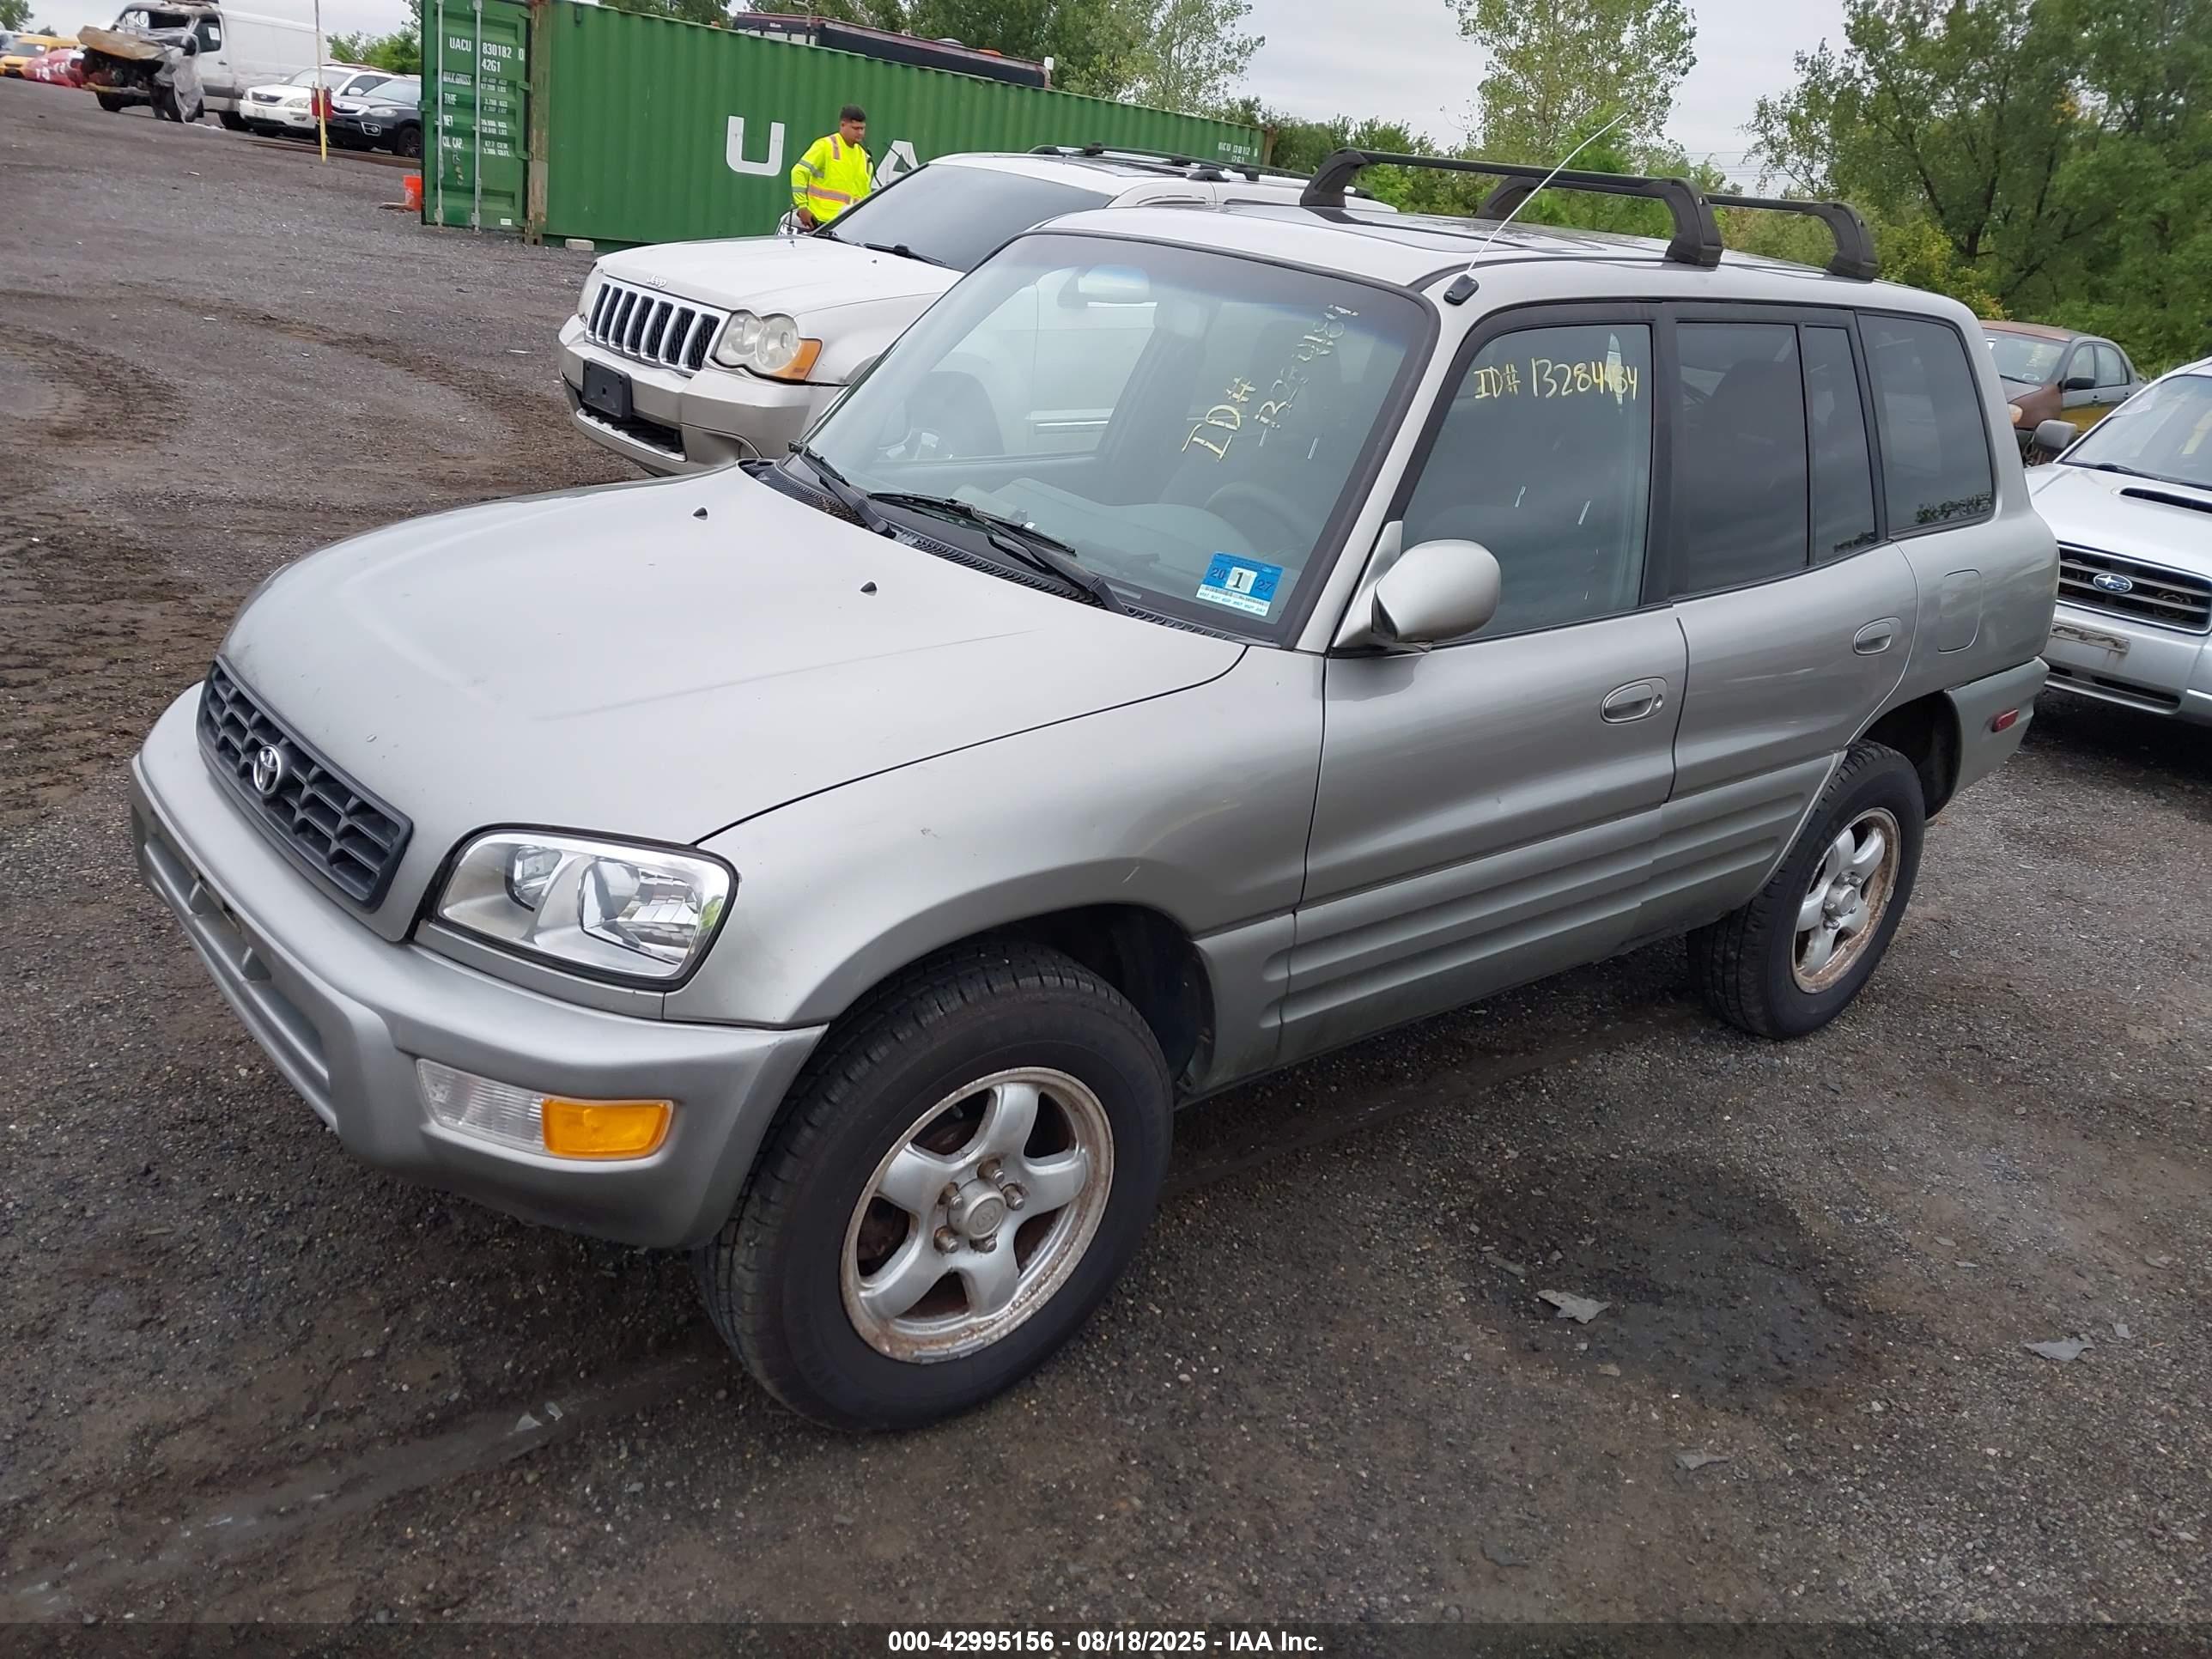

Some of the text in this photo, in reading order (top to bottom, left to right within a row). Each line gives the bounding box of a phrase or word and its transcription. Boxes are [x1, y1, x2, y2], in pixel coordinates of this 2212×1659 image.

[449, 36, 471, 52] UACU
[482, 42, 513, 59] 830182
[481, 58, 501, 73] 42G1
[646, 274, 667, 288] Jeep
[1473, 363, 1521, 399] ID#
[1182, 376, 1256, 462] ID#
